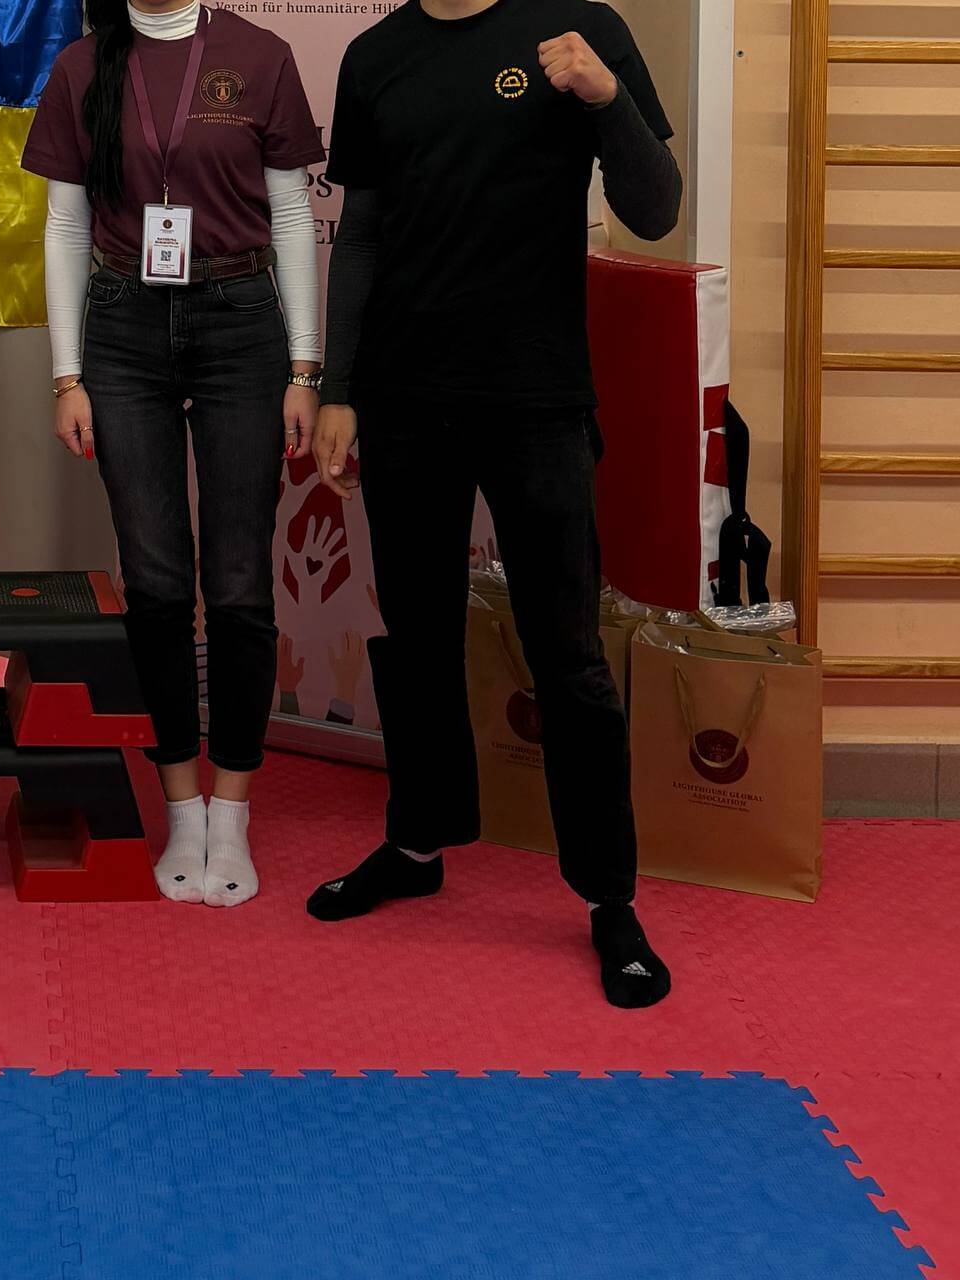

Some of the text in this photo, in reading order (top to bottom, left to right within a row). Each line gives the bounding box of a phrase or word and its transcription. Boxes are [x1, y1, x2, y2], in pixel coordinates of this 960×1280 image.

[216, 1, 398, 14] Verein für humanitäre Hilf
[672, 781, 764, 803] LIGHTHOUSE GLOBAL
[692, 793, 747, 807] ASSOCIATION
